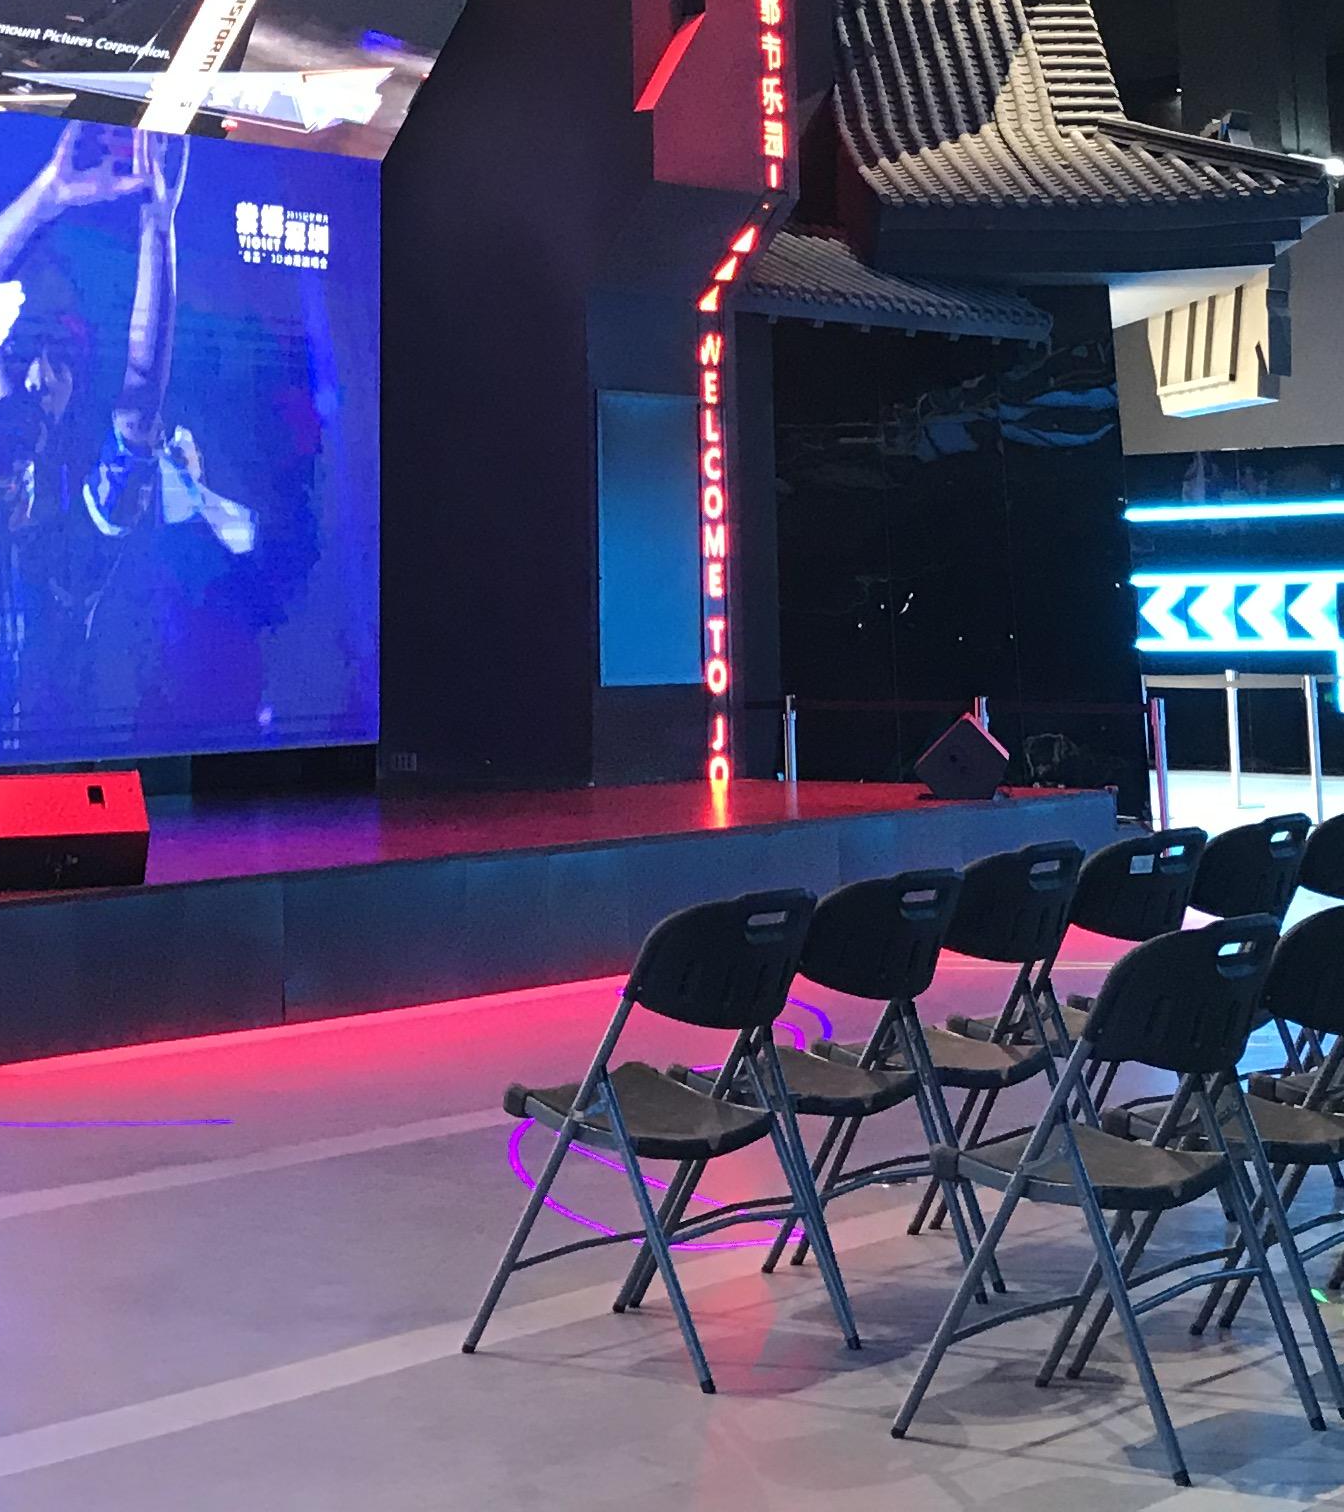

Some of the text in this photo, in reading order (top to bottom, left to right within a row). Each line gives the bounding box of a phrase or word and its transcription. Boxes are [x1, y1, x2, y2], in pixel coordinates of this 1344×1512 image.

[42, 28, 93, 49] Pictures
[699, 334, 729, 783] WELCOME TO JO
